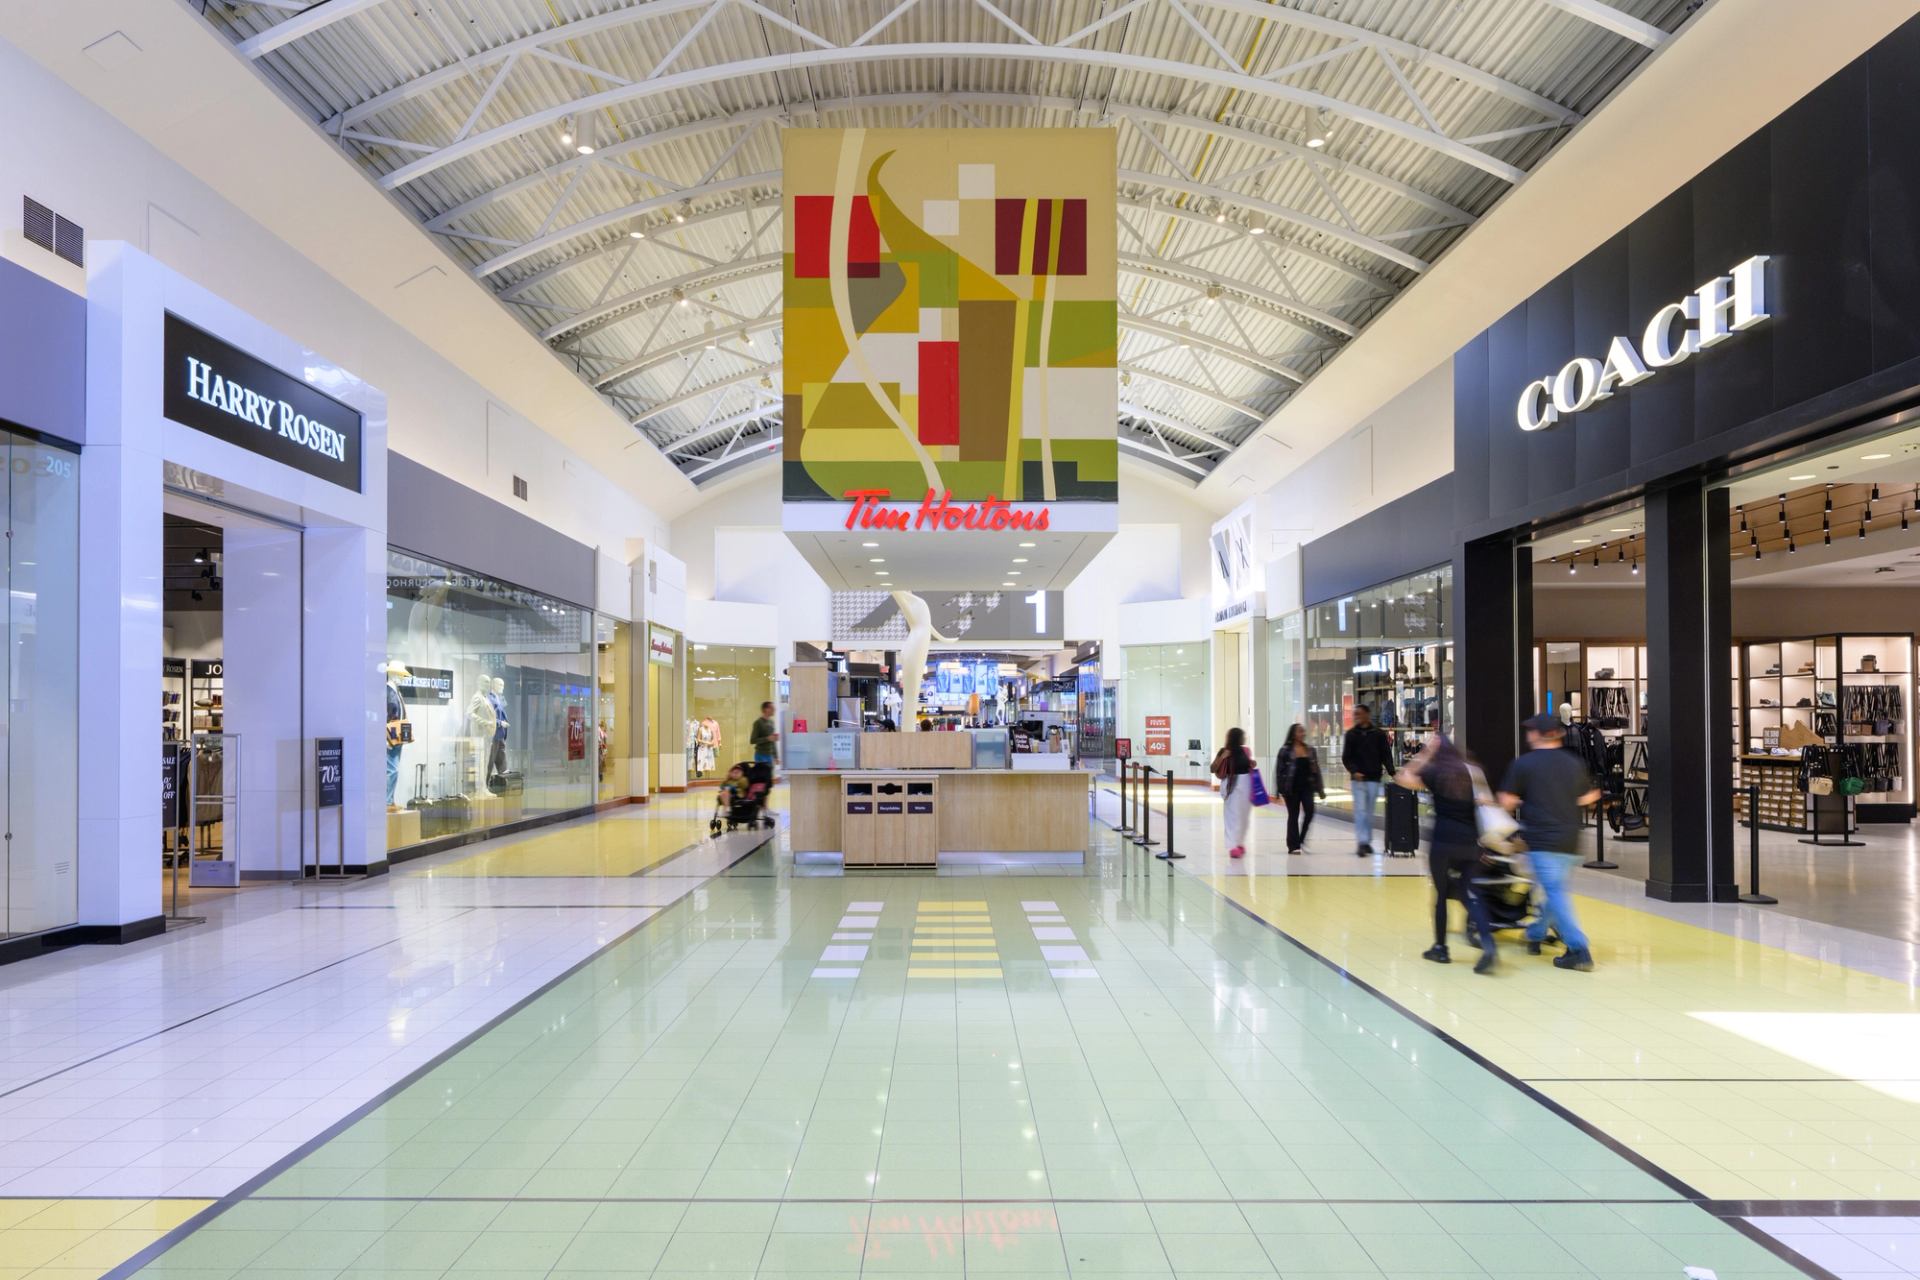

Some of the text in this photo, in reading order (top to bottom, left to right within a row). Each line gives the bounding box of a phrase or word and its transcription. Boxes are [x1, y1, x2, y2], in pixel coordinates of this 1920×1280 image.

[1517, 254, 1771, 432] COACH
[186, 356, 346, 463] HARRY ROSEN
[46, 455, 72, 479] 205
[843, 487, 1050, 532] Tim Hortons
